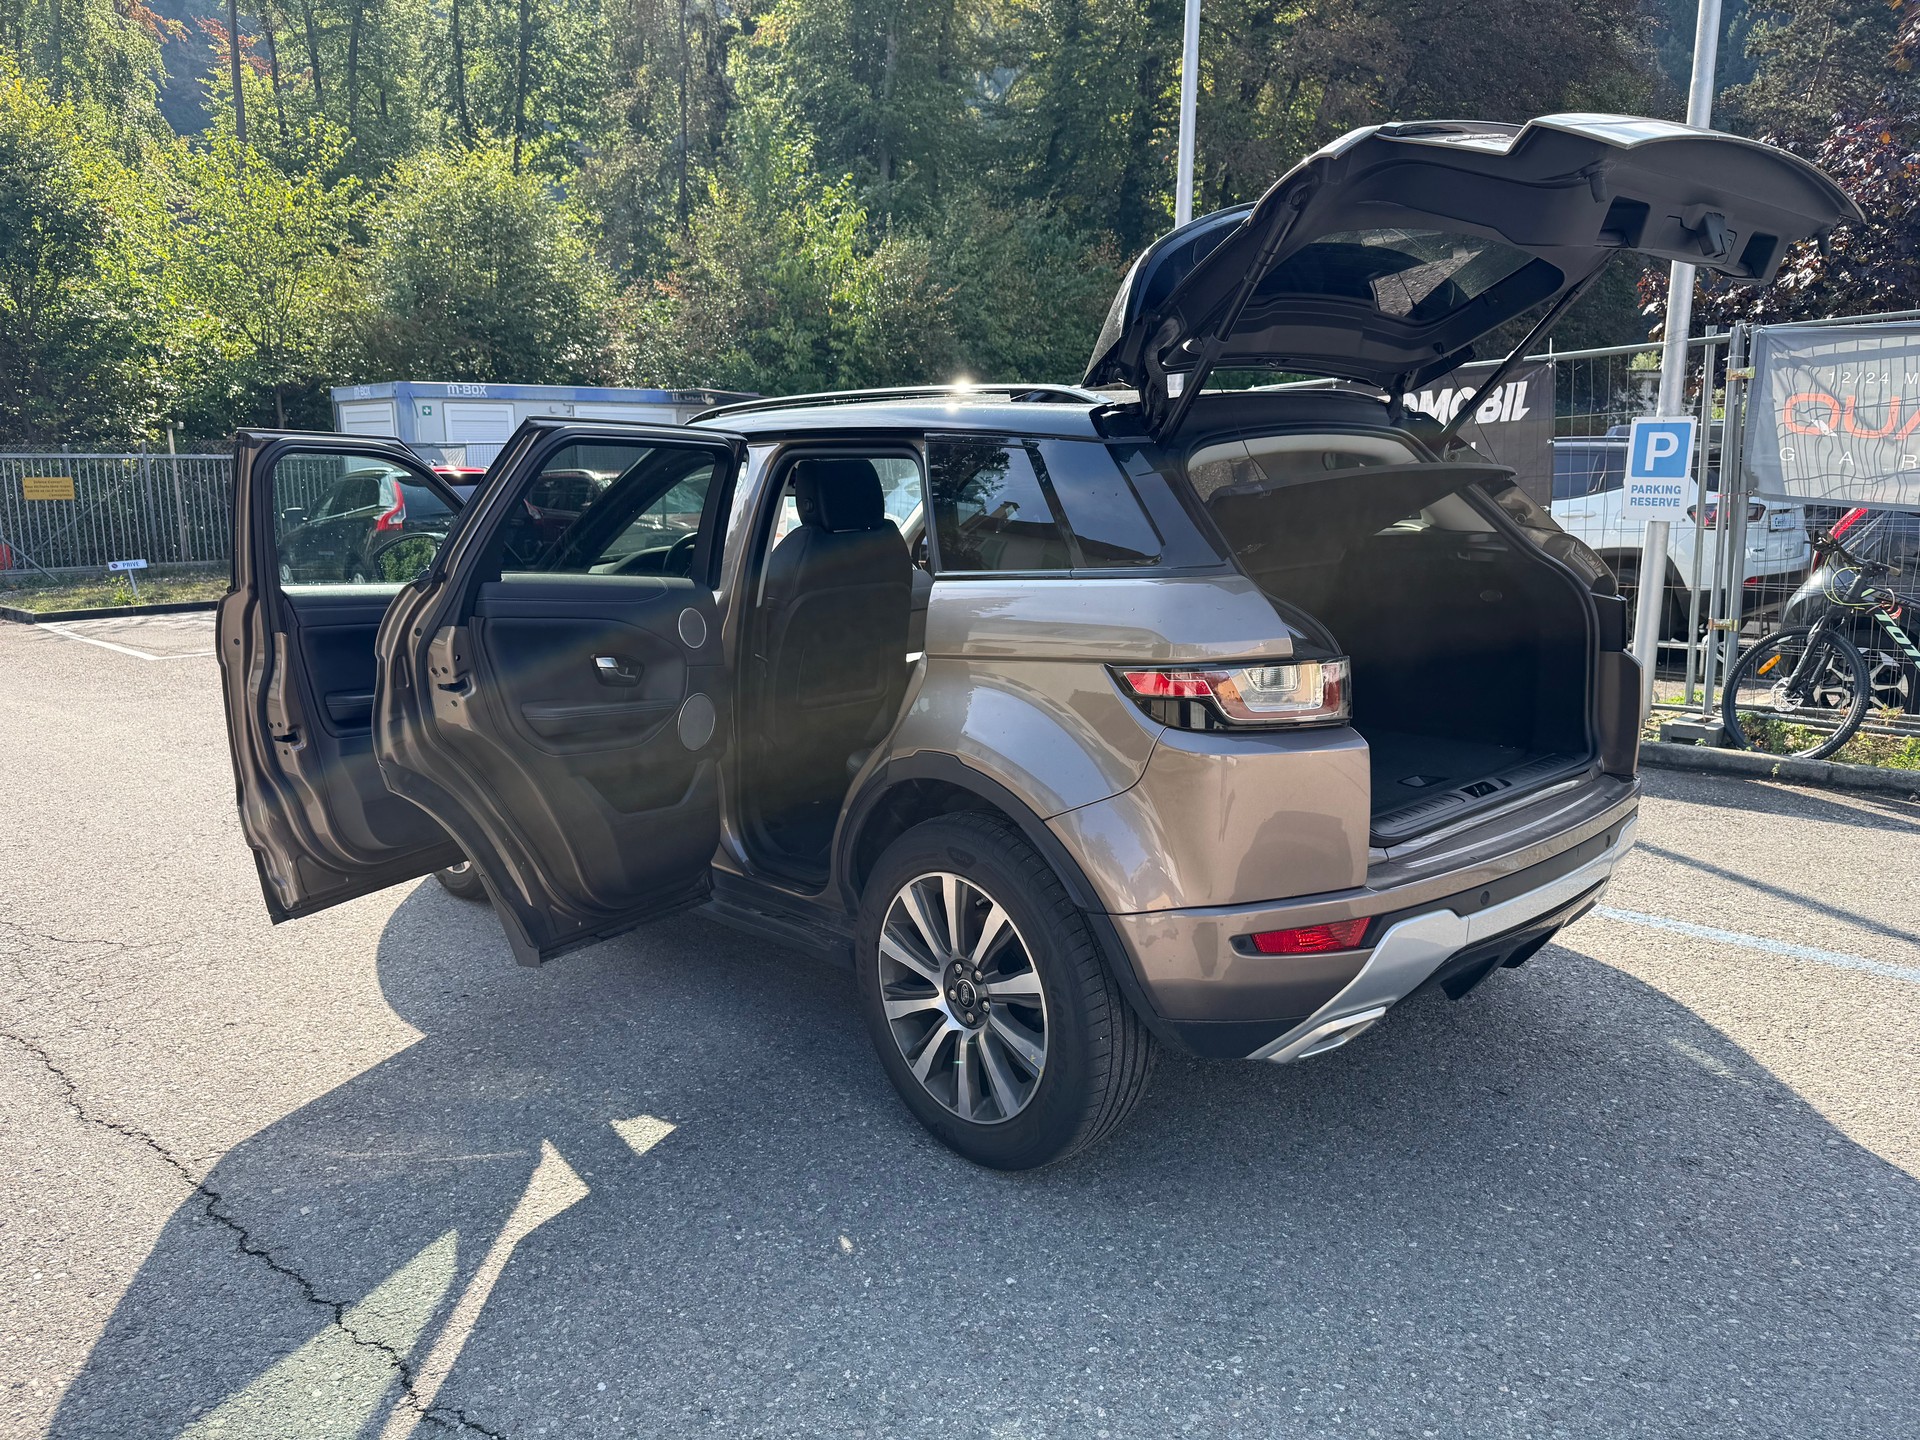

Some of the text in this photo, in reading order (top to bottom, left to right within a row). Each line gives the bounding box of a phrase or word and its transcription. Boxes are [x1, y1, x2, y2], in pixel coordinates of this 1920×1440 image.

[1828, 372, 1889, 384] 12/24
[1644, 431, 1679, 471] P
[1630, 484, 1682, 495] PARKING
[1629, 497, 1681, 507] RESERVE
